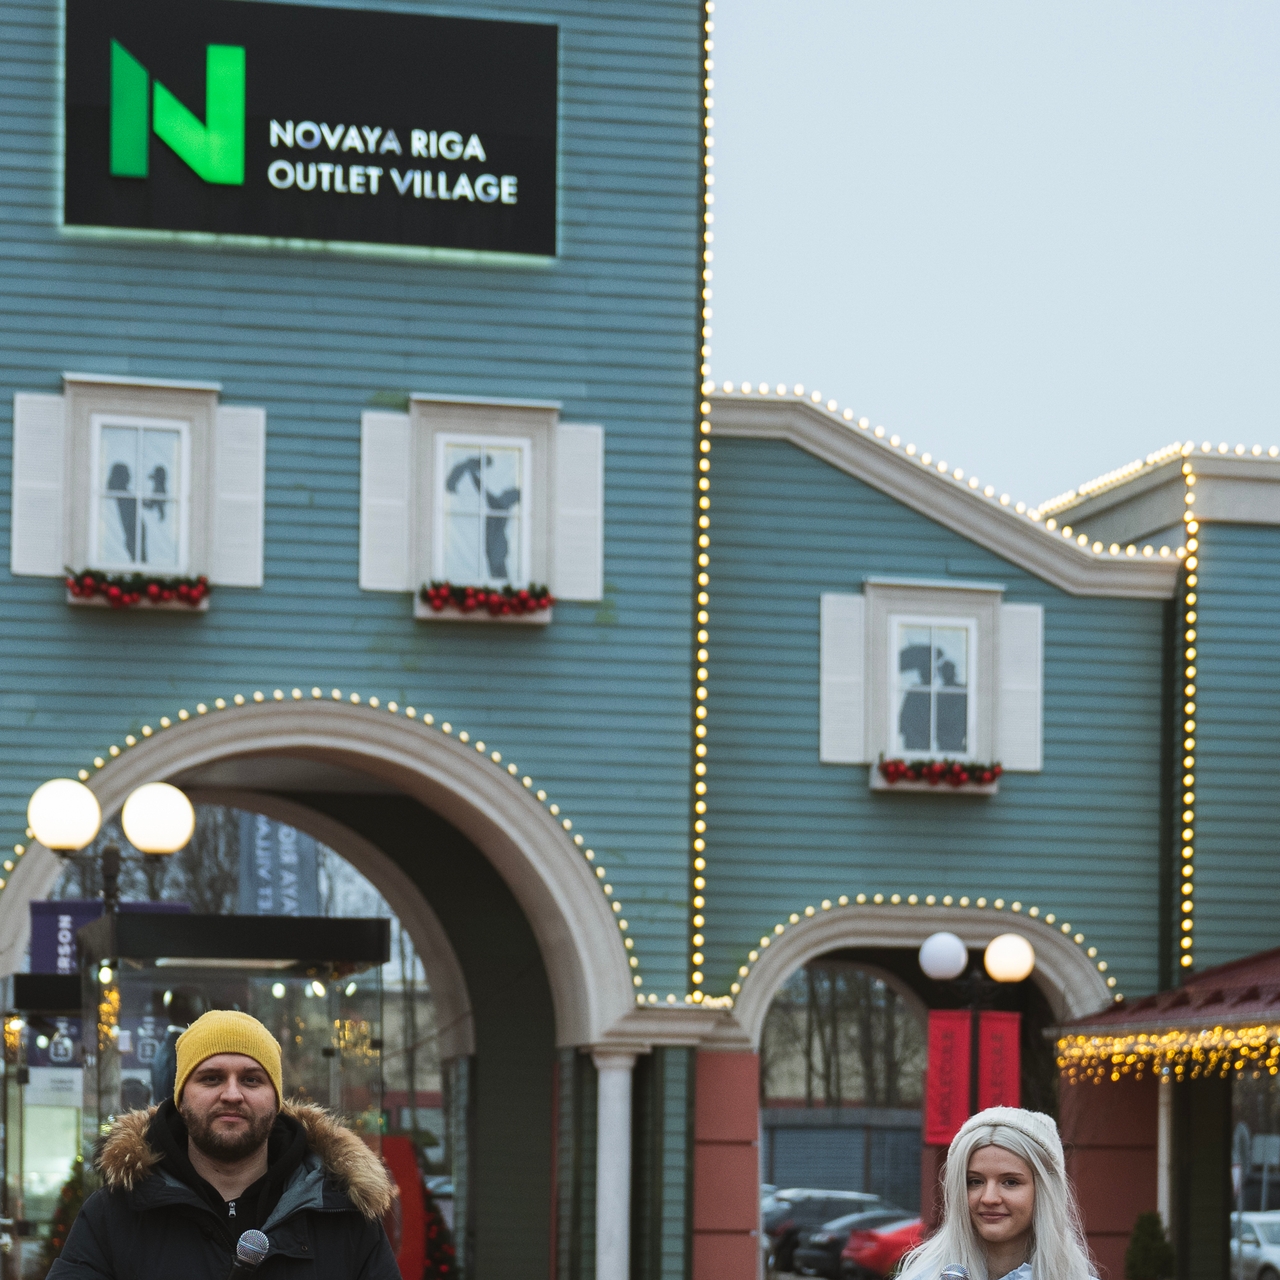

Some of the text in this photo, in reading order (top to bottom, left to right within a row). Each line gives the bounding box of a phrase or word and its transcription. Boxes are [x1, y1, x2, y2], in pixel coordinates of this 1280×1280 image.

[270, 119, 486, 162] NOVAYA RIGA
[267, 159, 518, 204] OUTLET VILLAGE
